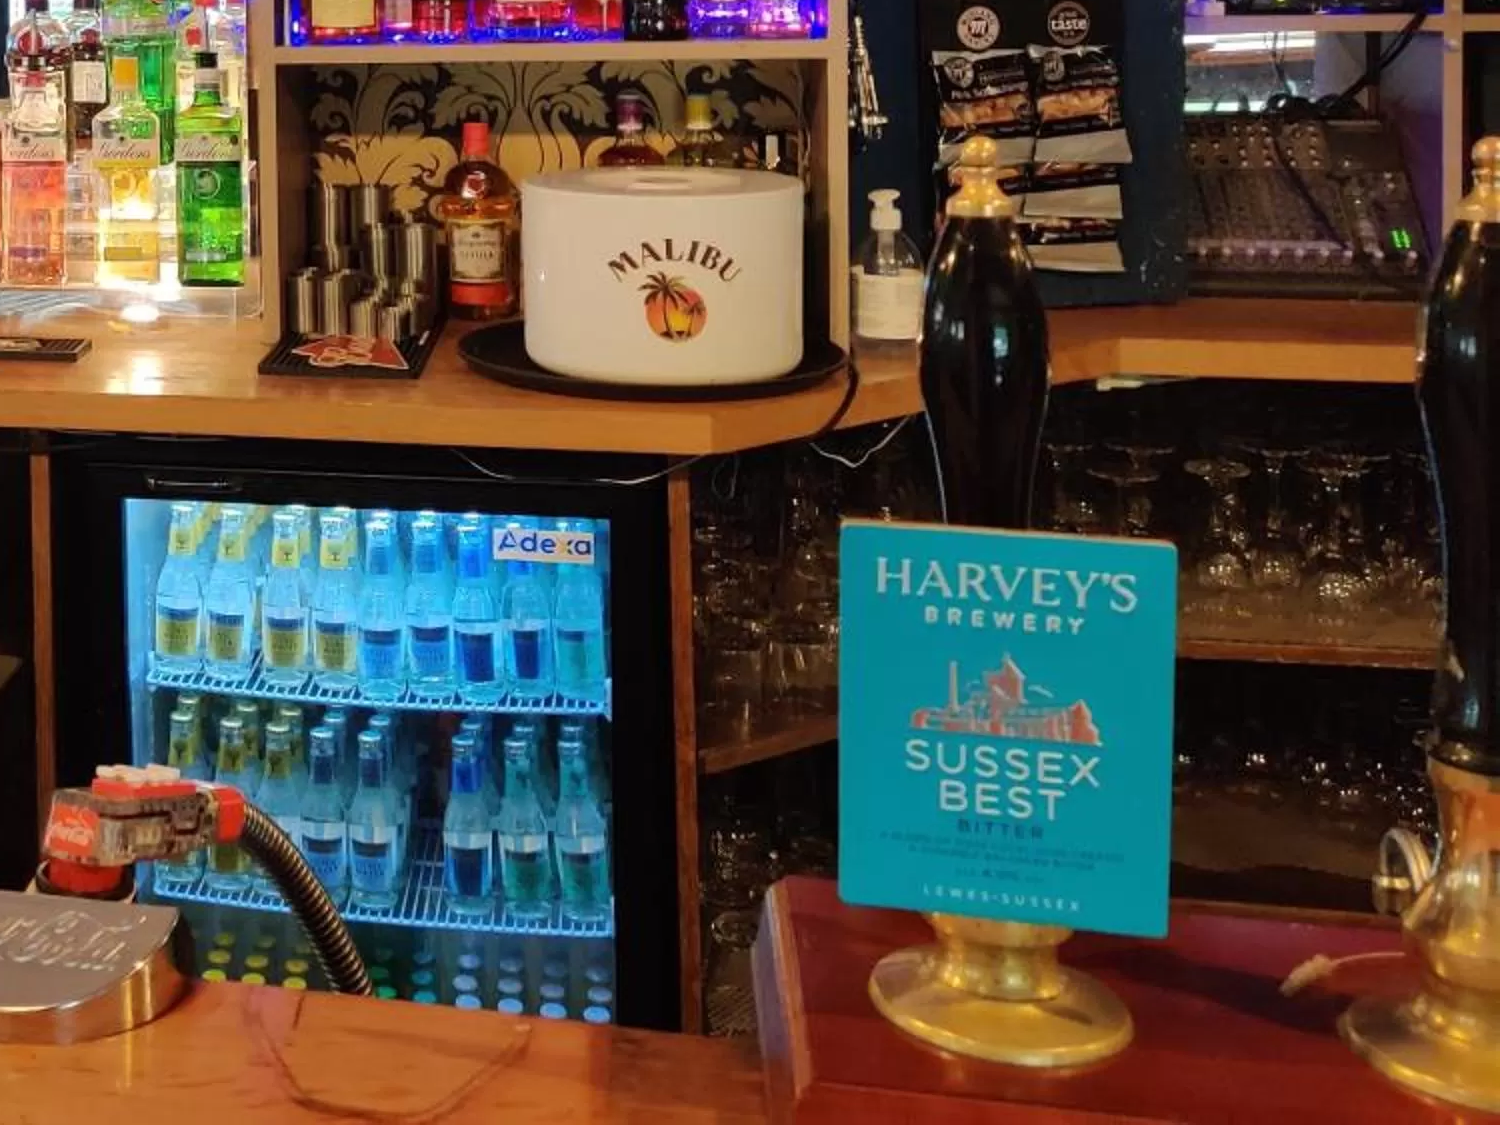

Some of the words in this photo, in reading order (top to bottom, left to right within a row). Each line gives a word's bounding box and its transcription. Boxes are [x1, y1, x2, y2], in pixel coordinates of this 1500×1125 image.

[607, 238, 743, 283] MALIBU
[876, 556, 1138, 613] HARVEY'S
[924, 606, 1085, 635] BREWERY
[905, 739, 1101, 789] SUSSEX
[939, 780, 1067, 821] BEST
[956, 819, 1045, 840] BITTER
